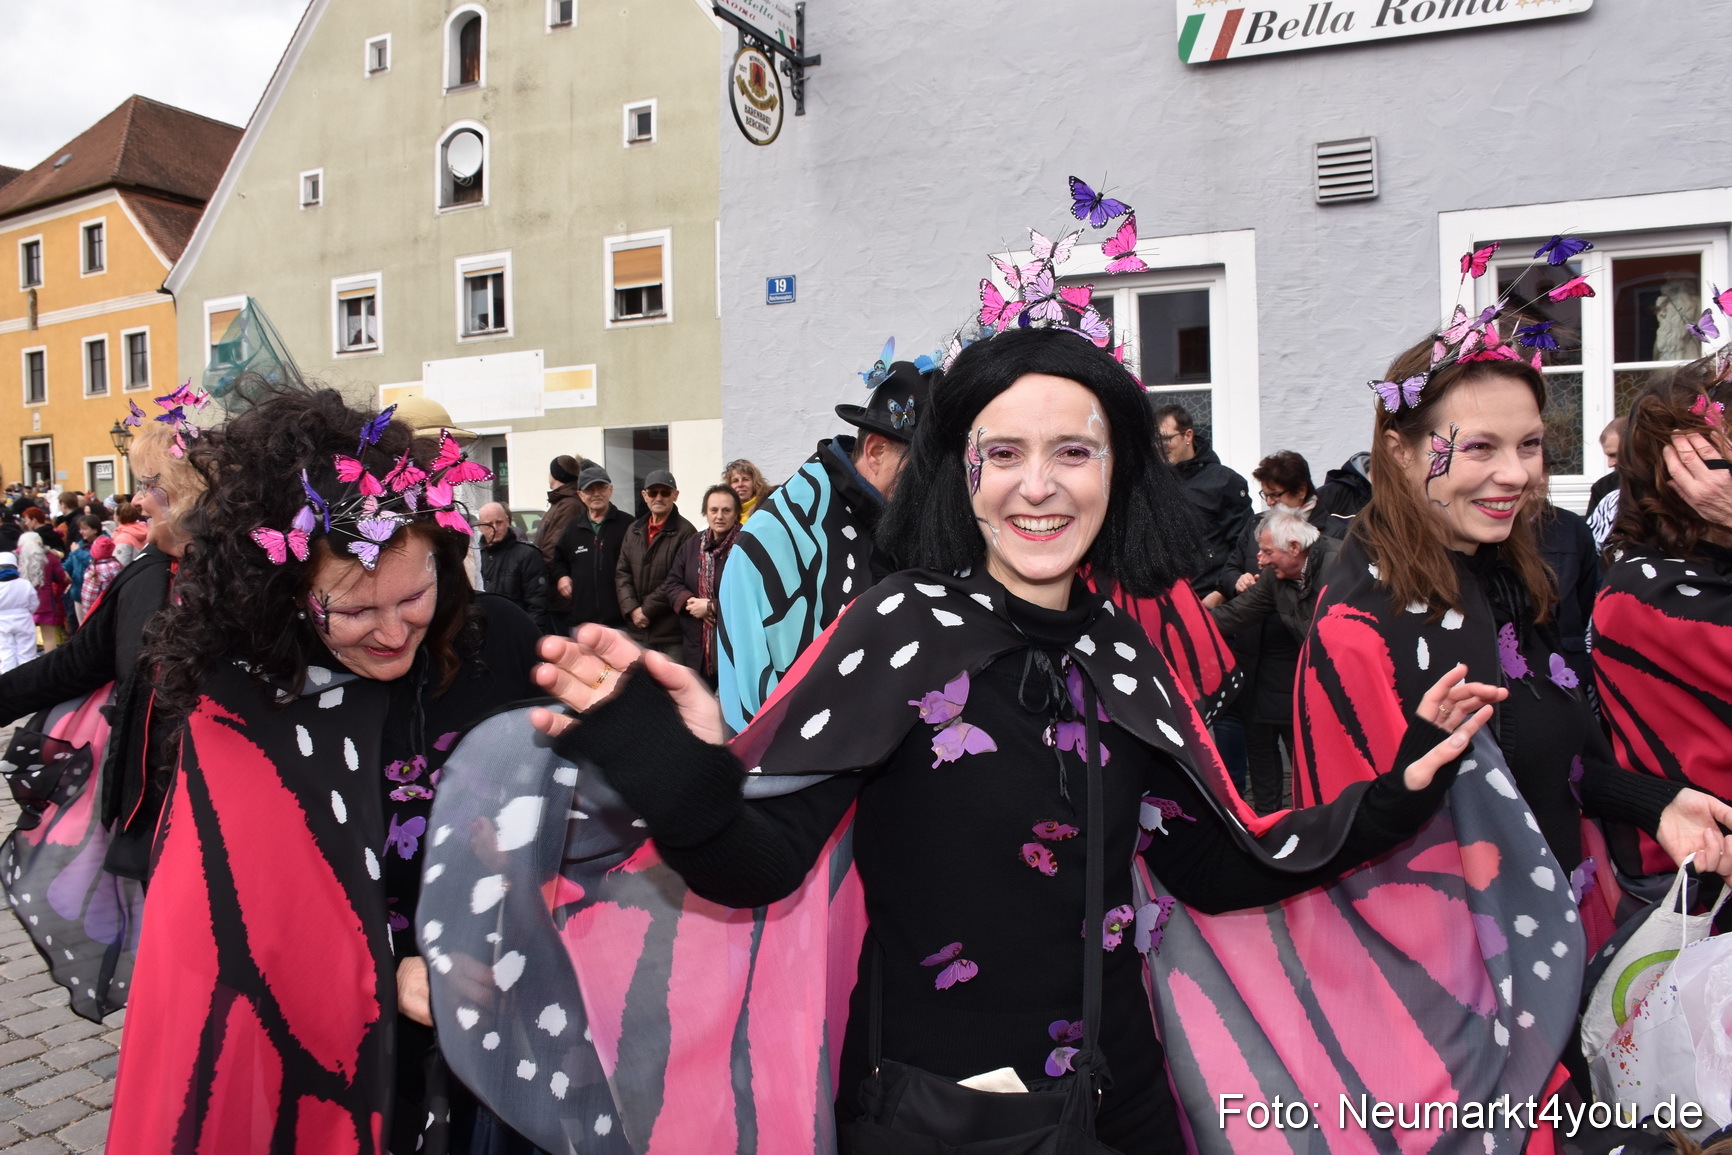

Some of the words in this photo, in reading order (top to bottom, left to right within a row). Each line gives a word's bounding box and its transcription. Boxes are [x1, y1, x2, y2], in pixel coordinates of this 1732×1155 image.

[1241, 1, 1355, 45] Bella
[1370, 0, 1509, 28] Roma
[774, 279, 787, 293] 19
